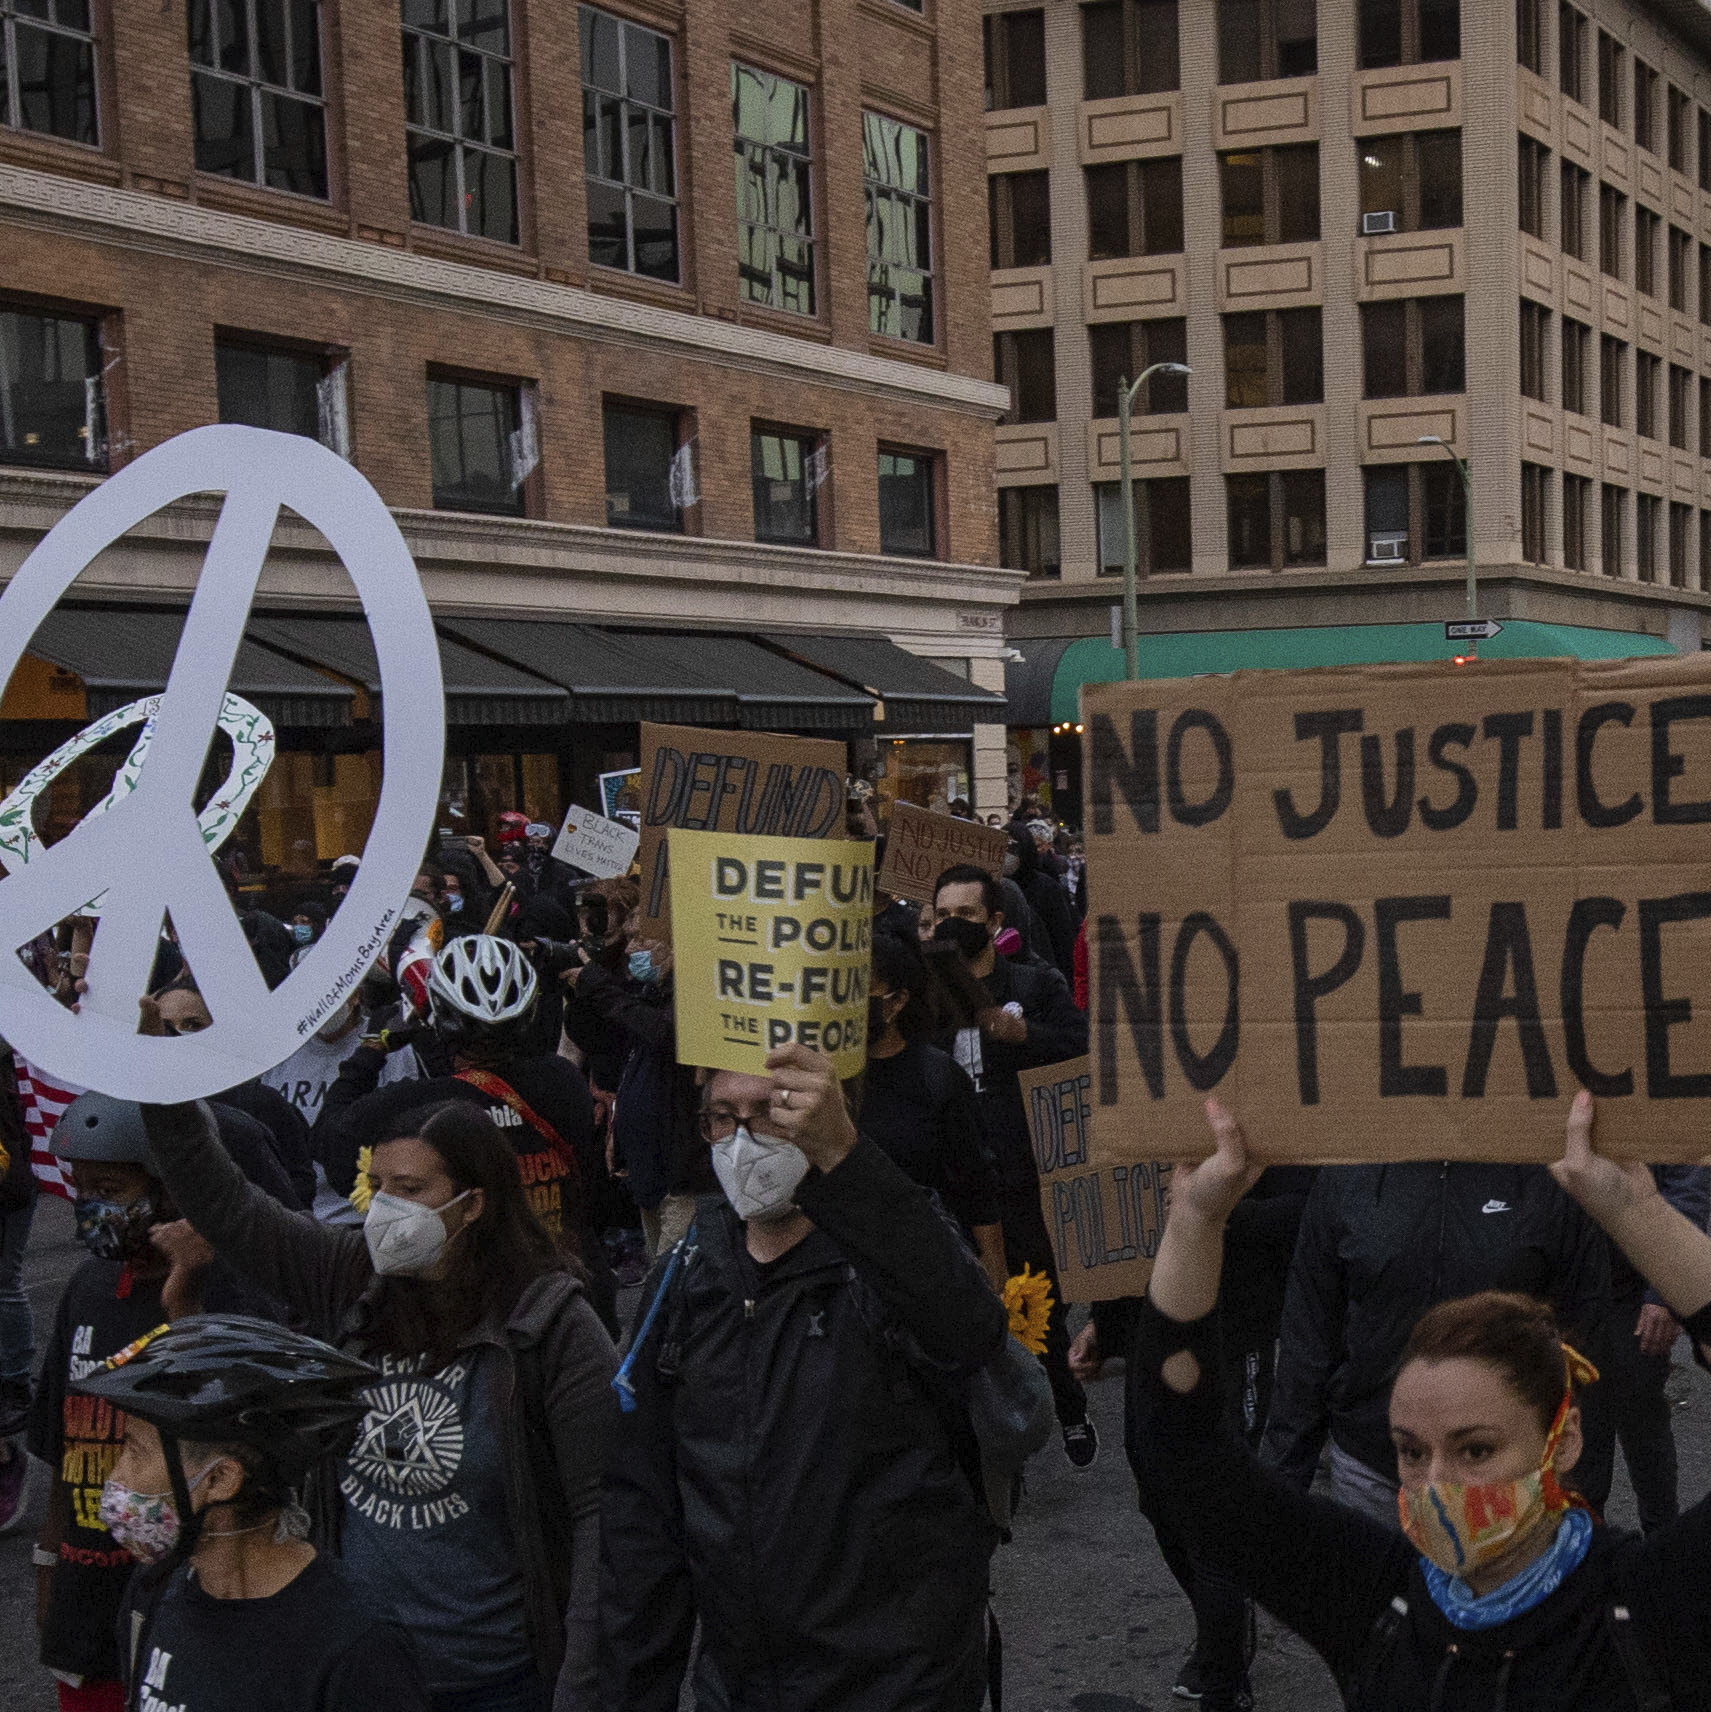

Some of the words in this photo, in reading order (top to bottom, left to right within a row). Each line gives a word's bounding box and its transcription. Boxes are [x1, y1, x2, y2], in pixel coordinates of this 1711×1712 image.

[1451, 626, 1467, 634] ONE
[1470, 625, 1487, 633] WAY
[646, 747, 840, 839] DEFUND
[1091, 707, 1235, 836] NO
[901, 818, 934, 849] NO
[893, 848, 931, 880] NO
[716, 912, 758, 932] THE
[720, 1013, 759, 1034] THE
[1095, 911, 1240, 1106] NO
[1053, 1160, 1173, 1272] POLICE
[340, 1475, 405, 1530] BLACK
[411, 1493, 470, 1530] LIVES
